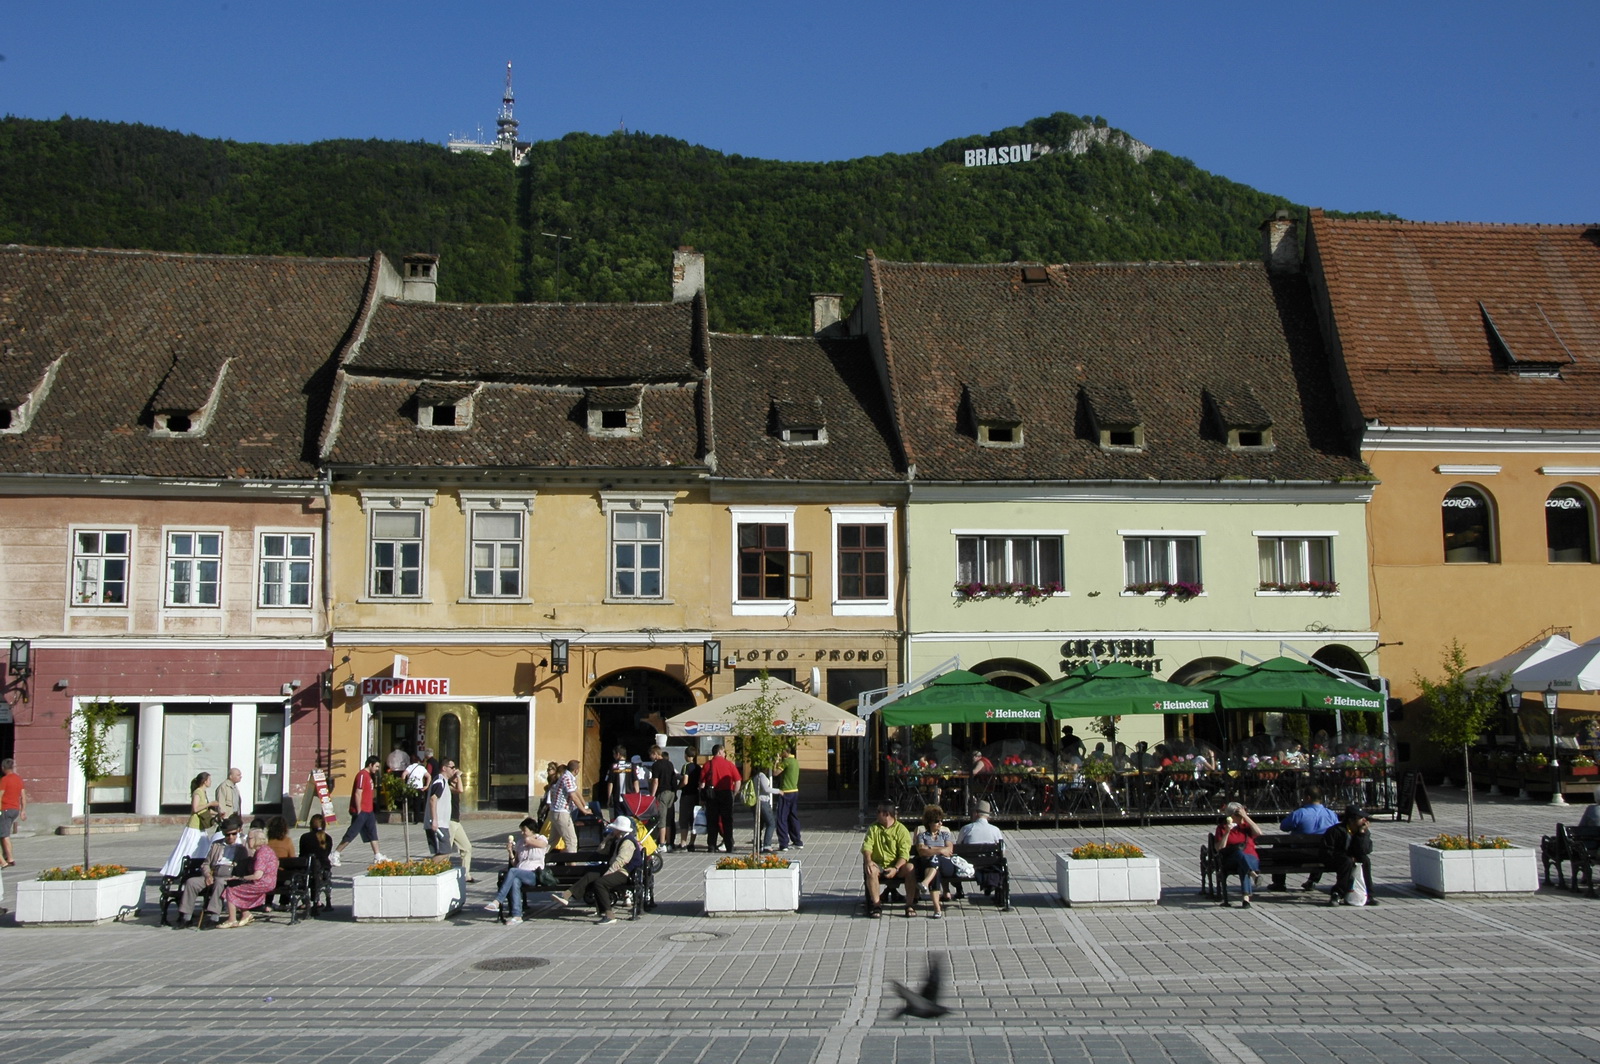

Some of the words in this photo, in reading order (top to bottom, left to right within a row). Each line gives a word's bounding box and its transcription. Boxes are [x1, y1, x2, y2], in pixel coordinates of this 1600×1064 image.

[965, 144, 1031, 167] BRASOV
[734, 649, 789, 662] LOTO
[815, 649, 885, 662] PRONO
[363, 679, 447, 694] EXCHANGE
[1162, 700, 1209, 710] Heineken
[1333, 696, 1380, 708] Heineken
[995, 709, 1041, 719] Heineken
